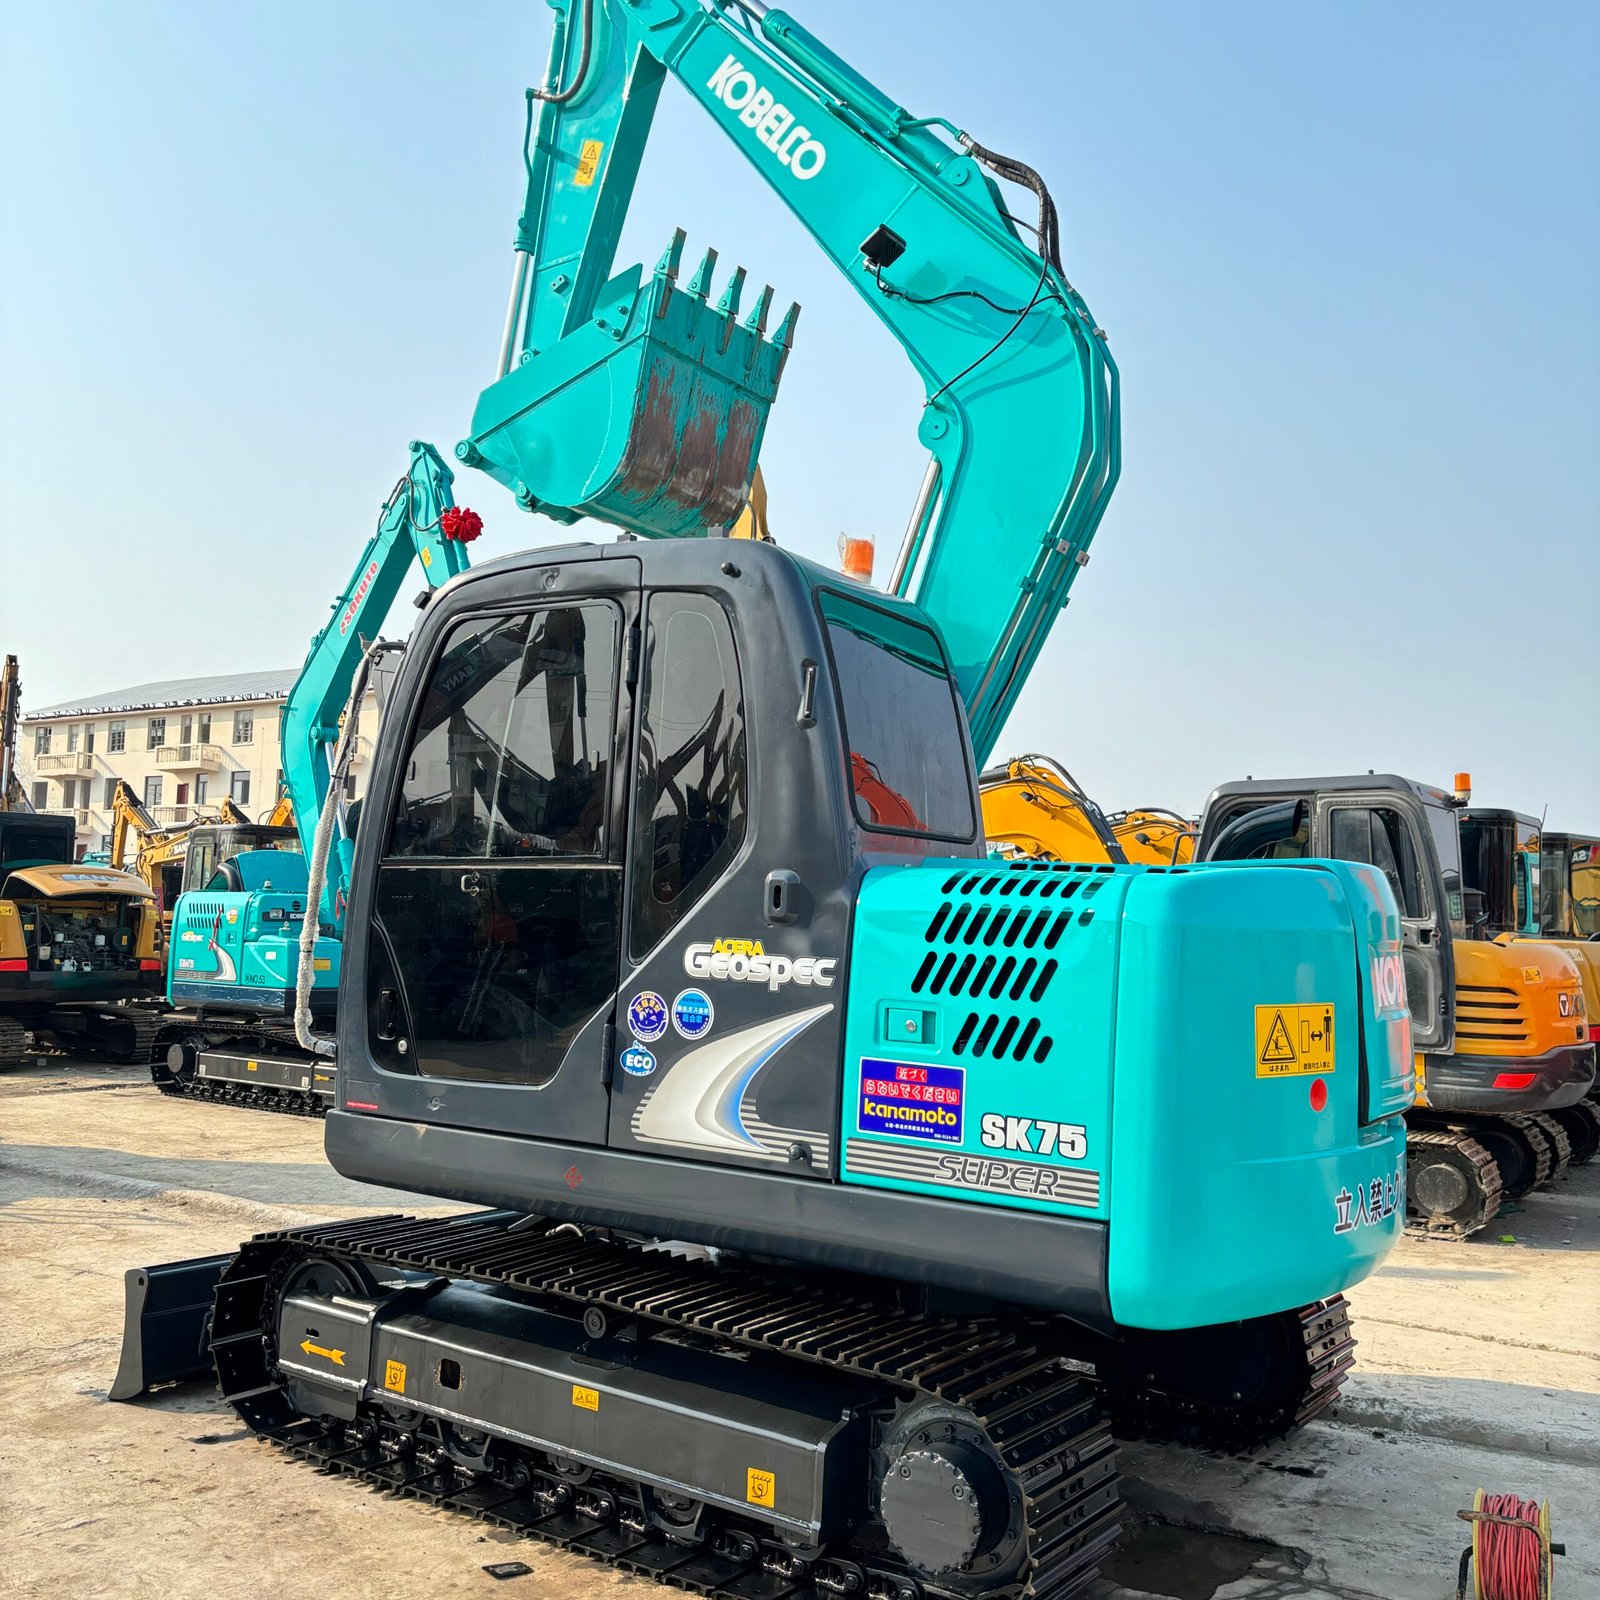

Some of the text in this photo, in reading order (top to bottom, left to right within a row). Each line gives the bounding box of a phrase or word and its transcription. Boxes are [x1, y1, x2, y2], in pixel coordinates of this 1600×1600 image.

[706, 53, 826, 180] KOBELCO
[711, 938, 765, 956] ACERA
[626, 1053, 653, 1070] ECO
[1268, 1064, 1290, 1073] はさまれ
[863, 1097, 957, 1126] kanamoto
[980, 1112, 1088, 1160] SK75
[934, 1155, 1061, 1197] SUPER
